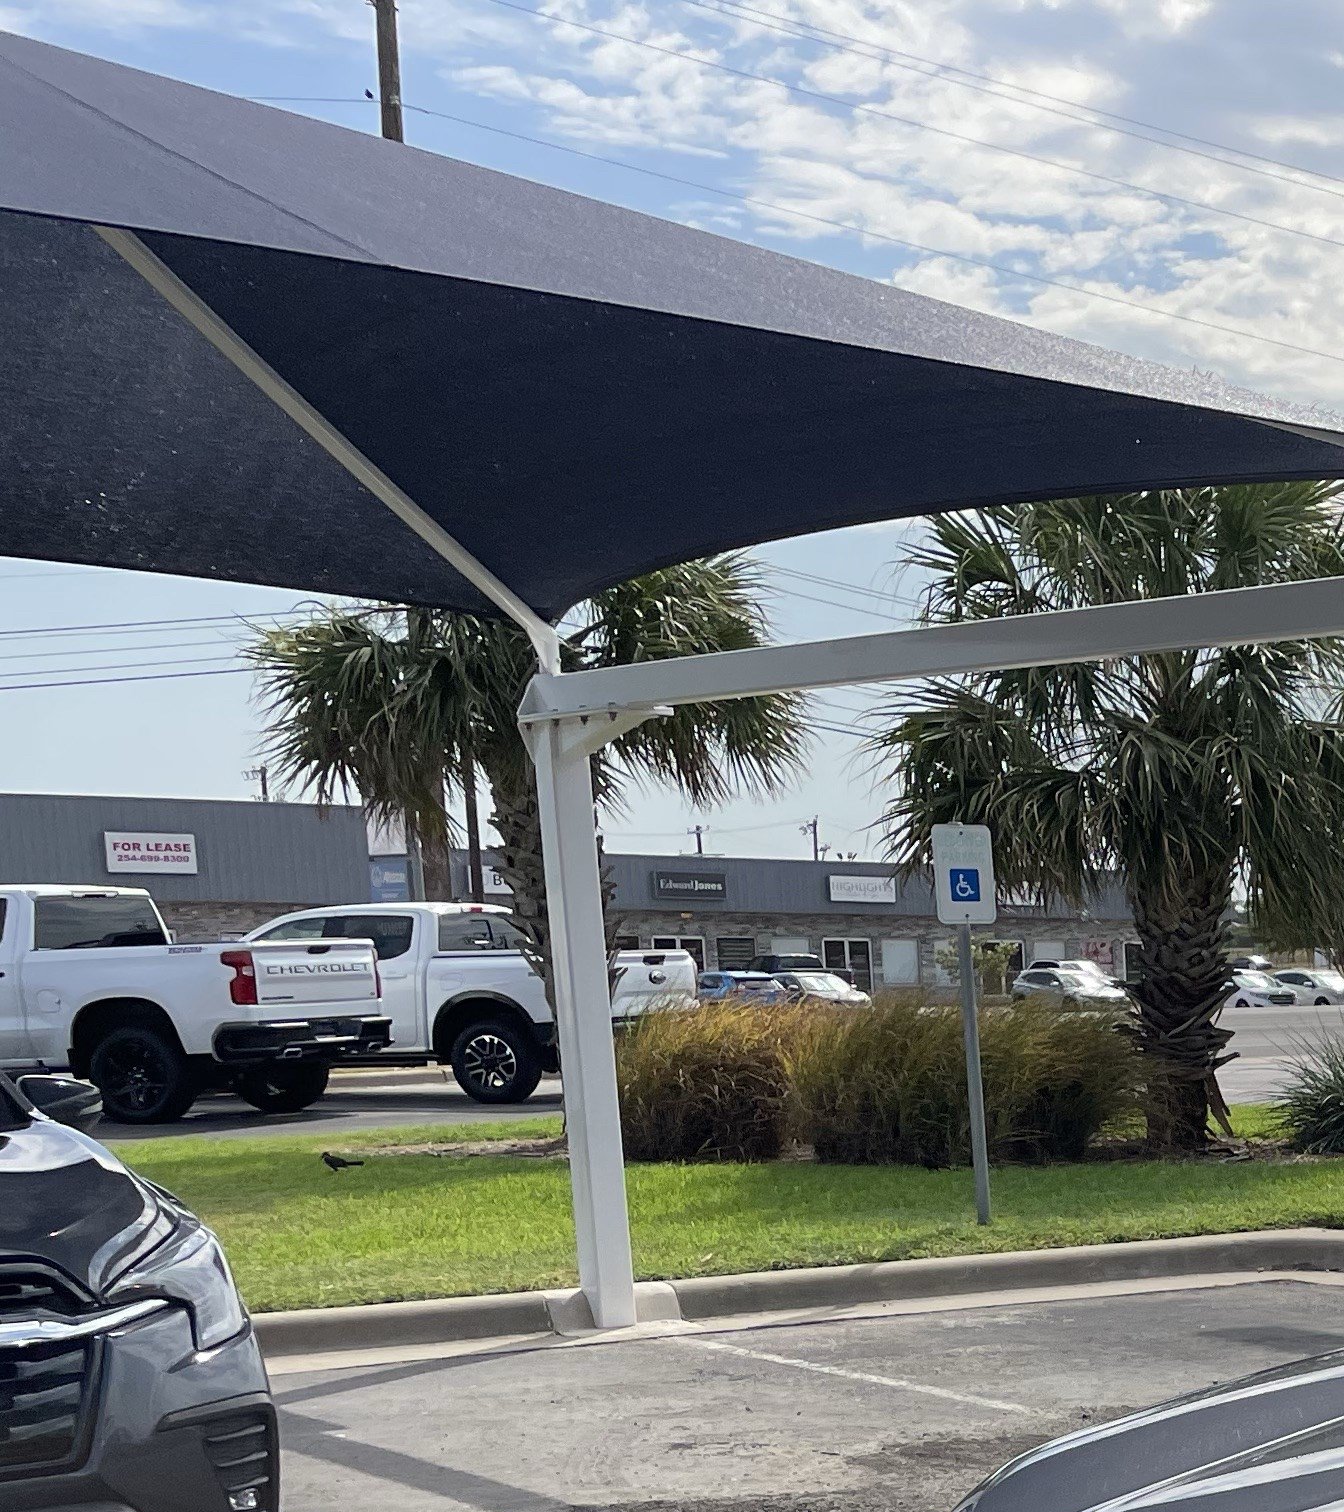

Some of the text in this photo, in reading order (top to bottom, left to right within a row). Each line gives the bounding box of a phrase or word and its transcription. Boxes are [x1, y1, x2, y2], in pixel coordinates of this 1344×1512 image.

[112, 842, 191, 853] FOR LEASE
[266, 963, 370, 976] CHEVROLET
